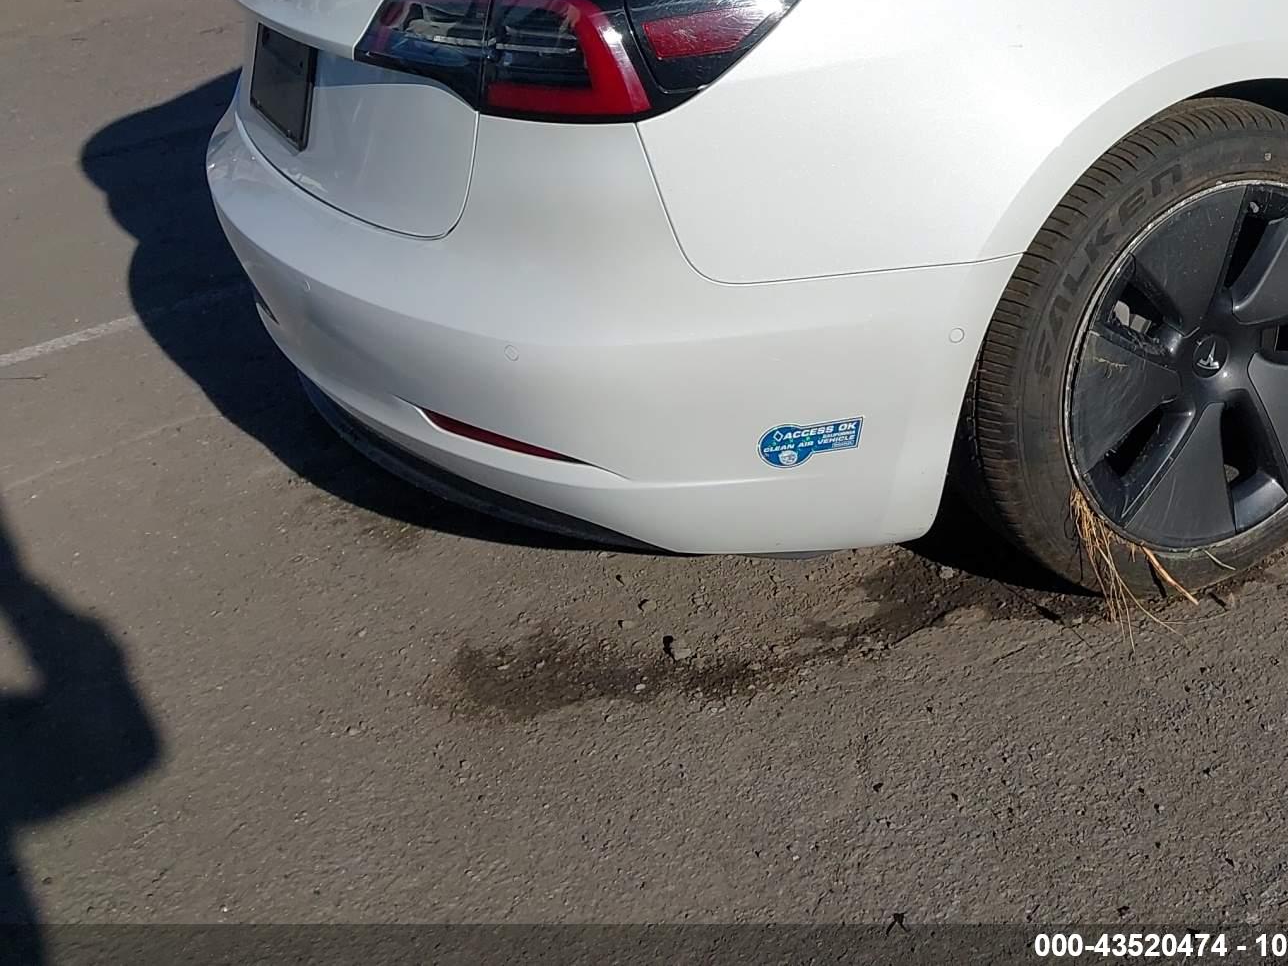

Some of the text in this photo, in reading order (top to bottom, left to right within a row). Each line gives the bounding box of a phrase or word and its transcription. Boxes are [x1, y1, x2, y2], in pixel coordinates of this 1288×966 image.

[783, 421, 857, 440] ACCESS OK
[763, 443, 795, 453] CLEAN
[817, 434, 856, 445] VEHICLE
